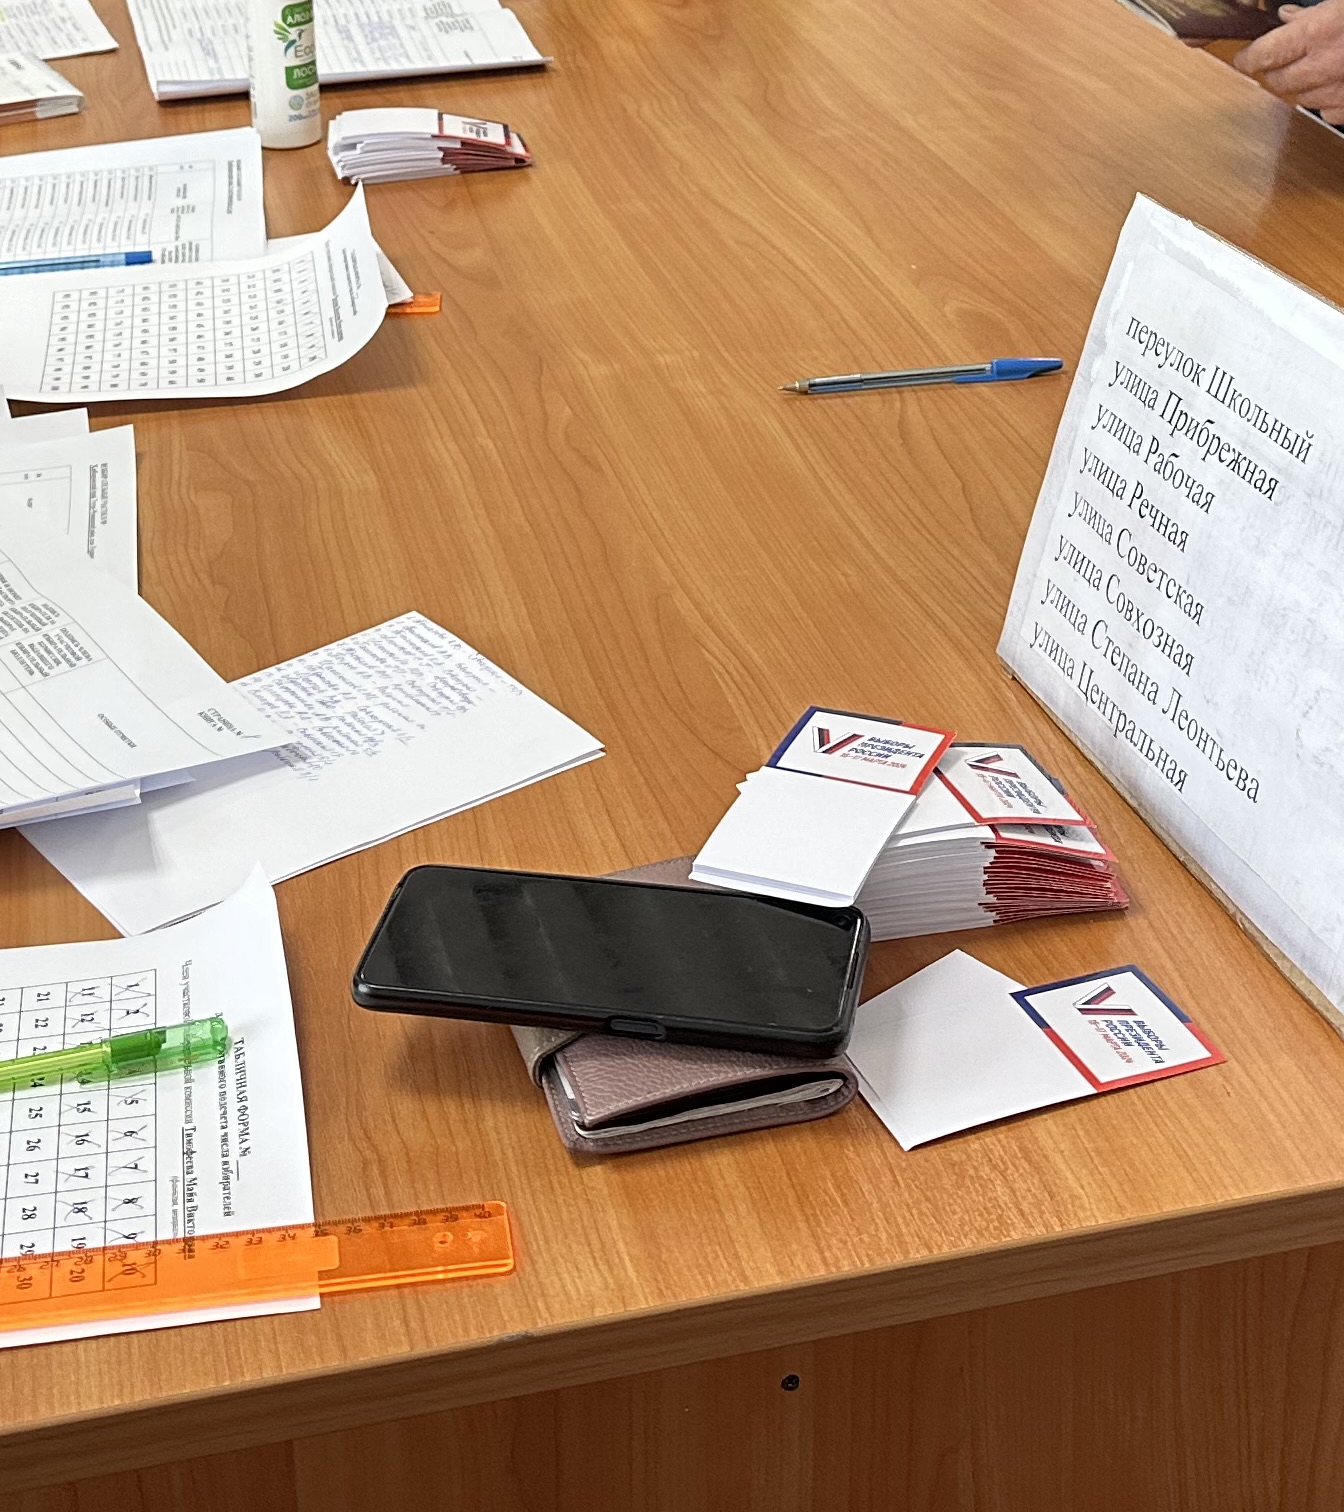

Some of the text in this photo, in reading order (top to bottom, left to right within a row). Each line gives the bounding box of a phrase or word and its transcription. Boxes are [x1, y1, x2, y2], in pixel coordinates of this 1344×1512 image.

[1108, 360, 1280, 502] улица Прибрежная
[1126, 316, 1315, 465] переулок Школьный
[1079, 446, 1190, 554] улица Речная
[1091, 403, 1217, 515] улица Рабочая
[1067, 491, 1205, 627] улица Советская
[1054, 534, 1195, 678] улица Совхозная
[1029, 621, 1189, 794] улица Центральная
[1040, 578, 1261, 804] улица Степана Леонтьева
[34, 1016, 49, 1029] 22
[36, 991, 51, 1003] 21
[28, 1106, 44, 1120] 25
[233, 1037, 249, 1104] ТАБЛИЧНАЯ
[25, 1138, 41, 1152] 26
[69, 986, 96, 1283] 11 12 15 16 17 18 19 20
[236, 1104, 250, 1145] ФОРМА
[21, 1206, 37, 1221] 28
[24, 1172, 40, 1185] 27
[16, 1275, 32, 1290] 30
